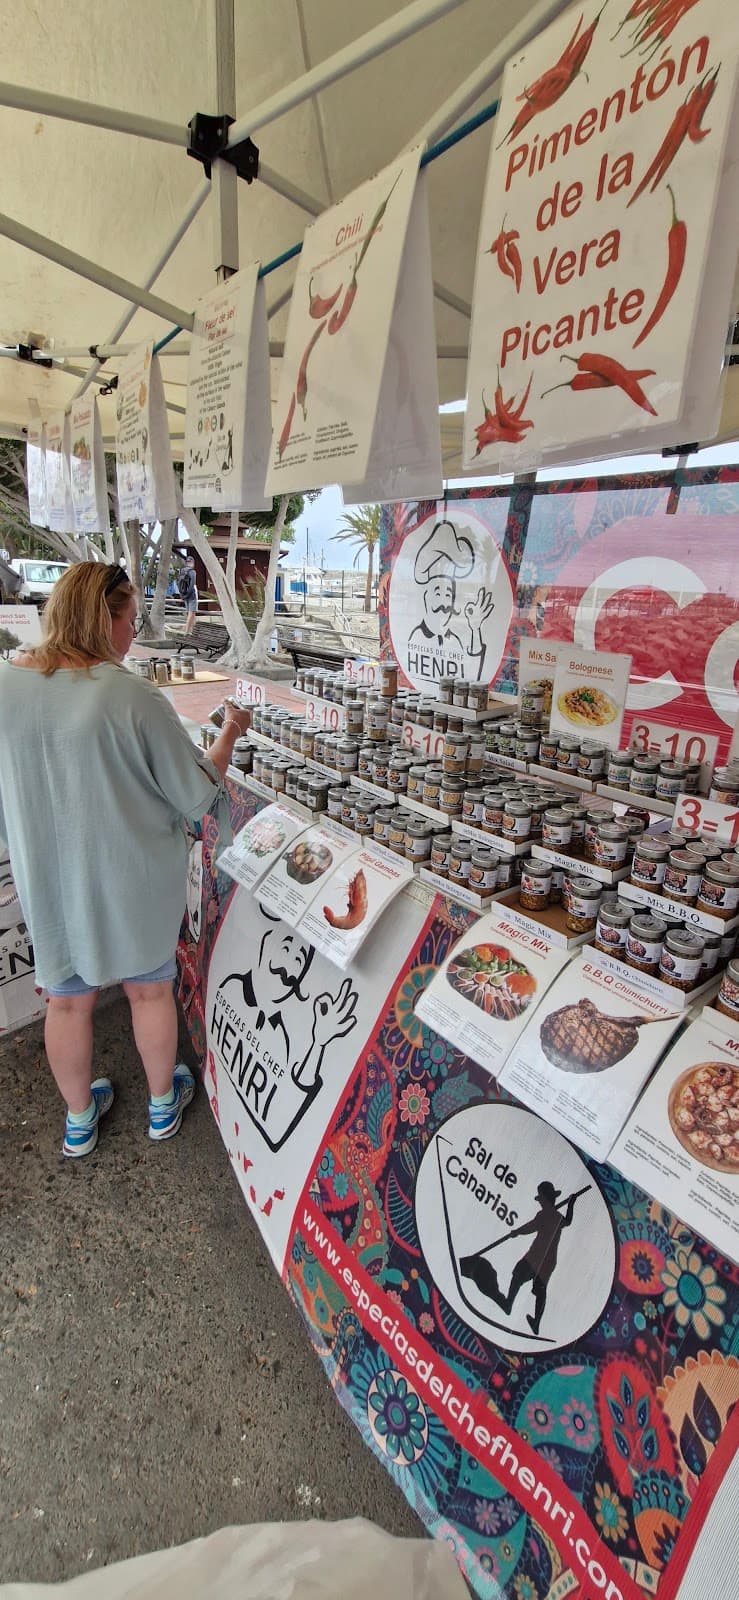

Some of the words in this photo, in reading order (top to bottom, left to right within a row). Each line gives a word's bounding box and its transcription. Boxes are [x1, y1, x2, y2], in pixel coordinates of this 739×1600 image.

[505, 36, 710, 192] Pimentón
[536, 181, 583, 231] de
[595, 152, 635, 201] la
[336, 213, 364, 247] Chili
[533, 229, 621, 295] Vera
[500, 288, 645, 368] Picante
[408, 643, 433, 655] ESPECIAS
[436, 649, 447, 657] DEL
[449, 653, 464, 662] CHEF
[529, 650, 543, 661] Mix
[545, 652, 557, 662] Sa
[569, 661, 613, 675] Bolognese
[554, 855, 578, 871] Magic
[578, 864, 595, 875] Mix
[514, 915, 536, 931] Magic
[537, 927, 552, 939] Mix
[647, 896, 664, 910] Mix
[668, 903, 704, 925] B.B.Q.
[497, 921, 530, 942] Magic
[530, 938, 552, 953] Mix
[582, 963, 615, 986] B.B.Q
[614, 982, 669, 1014] Chimichurri
[215, 990, 246, 1032] ESPECIAS
[245, 1030, 261, 1052] DEL
[262, 1050, 285, 1079] CHEF
[211, 1003, 278, 1122] HENRI
[465, 1136, 492, 1170] Sal
[493, 1161, 519, 1189] de
[446, 1155, 520, 1228] Canarias
